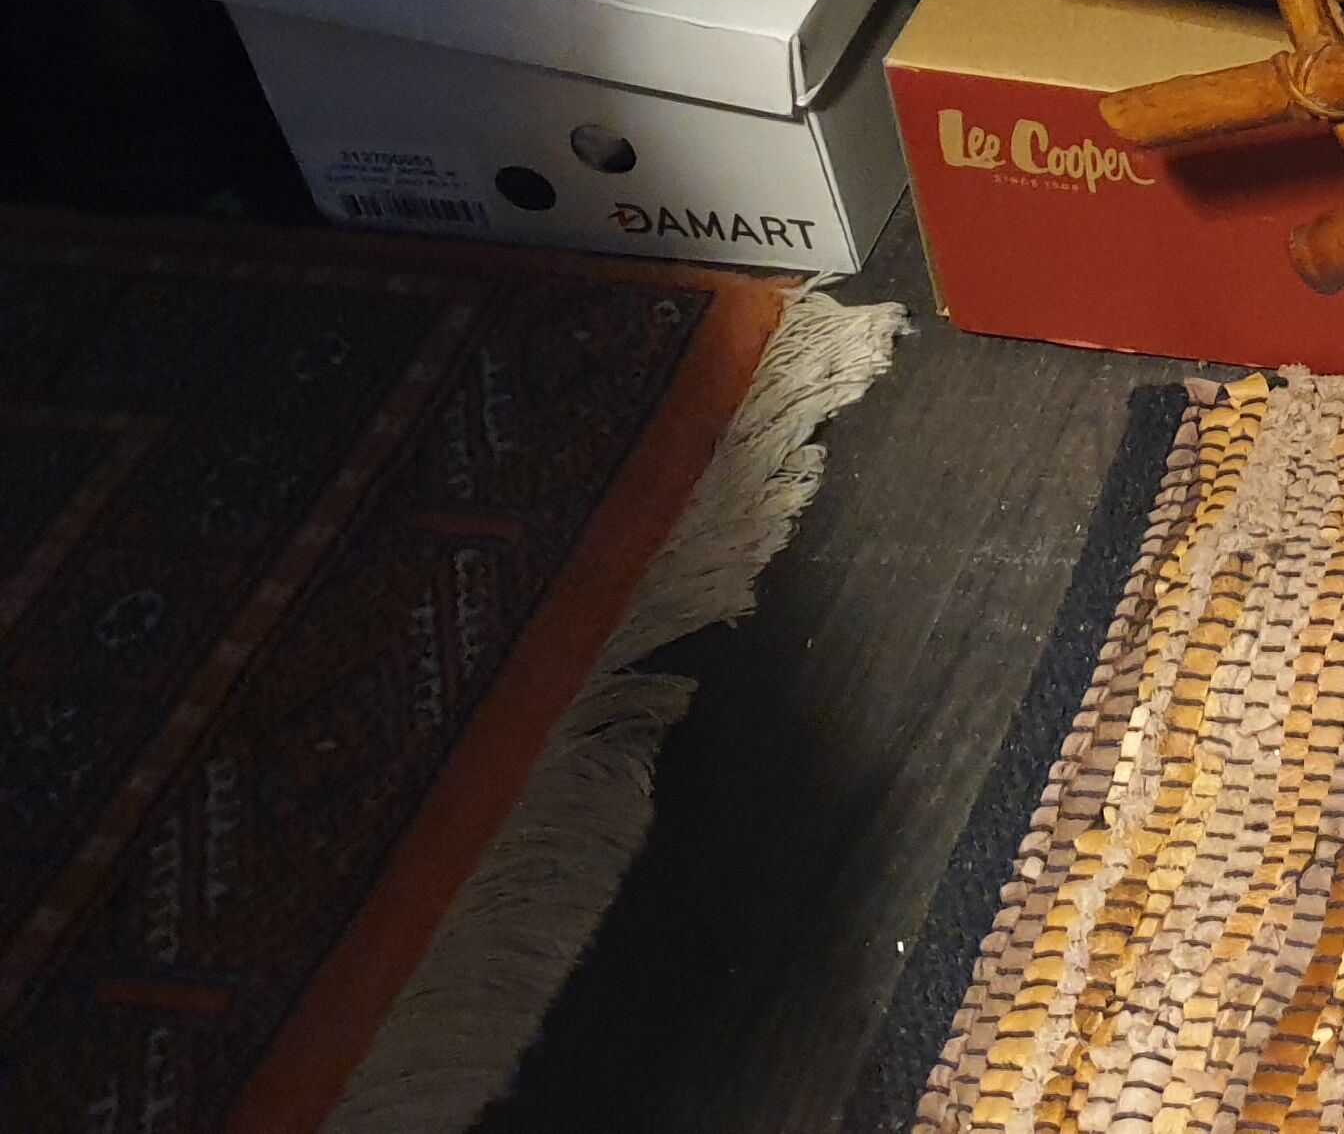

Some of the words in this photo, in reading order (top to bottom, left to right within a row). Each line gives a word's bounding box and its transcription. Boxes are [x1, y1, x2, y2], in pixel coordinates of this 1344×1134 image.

[938, 109, 1006, 168] Lee
[1011, 119, 1156, 194] Cooper
[609, 201, 816, 250] DAMART
